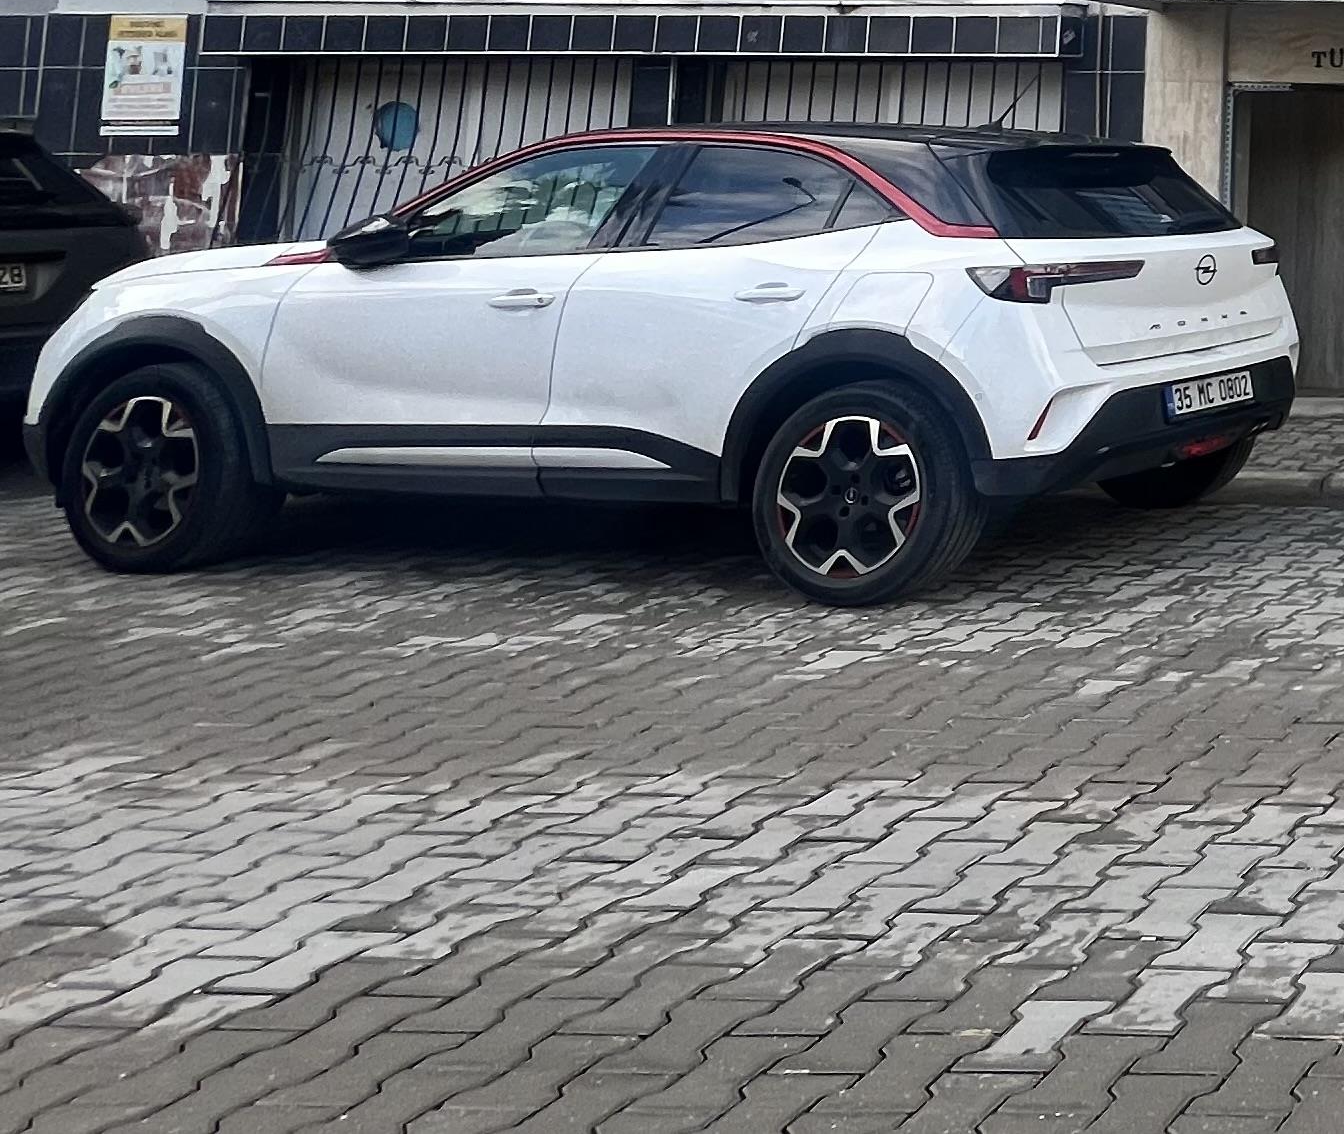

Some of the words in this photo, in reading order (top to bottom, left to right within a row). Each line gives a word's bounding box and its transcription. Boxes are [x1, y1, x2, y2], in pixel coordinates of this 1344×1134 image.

[1175, 386, 1193, 411] 35
[1197, 382, 1215, 406] MC
[1219, 374, 1250, 401] 0802
